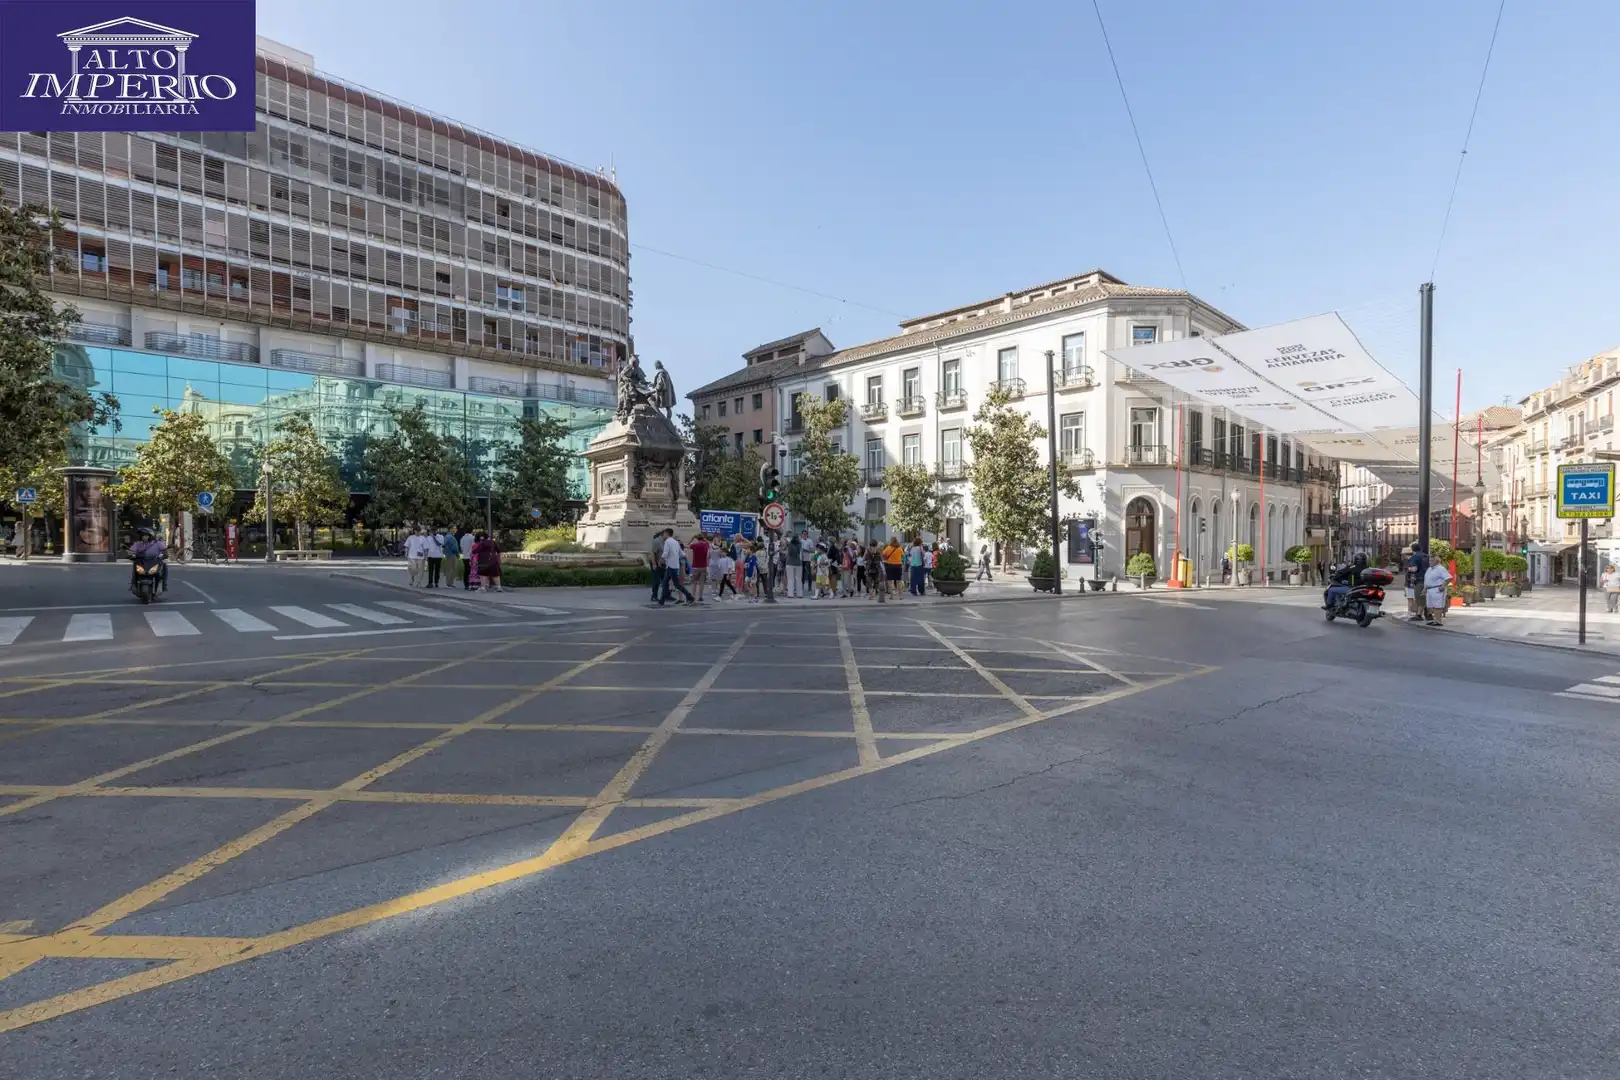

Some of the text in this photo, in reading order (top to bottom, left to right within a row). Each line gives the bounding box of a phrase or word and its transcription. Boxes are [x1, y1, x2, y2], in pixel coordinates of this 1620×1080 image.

[1264, 348, 1337, 363] CERVEZAS
[1267, 353, 1346, 368] ALHAMBRA
[1570, 491, 1601, 500] TAXI
[702, 513, 734, 524] atlanta
